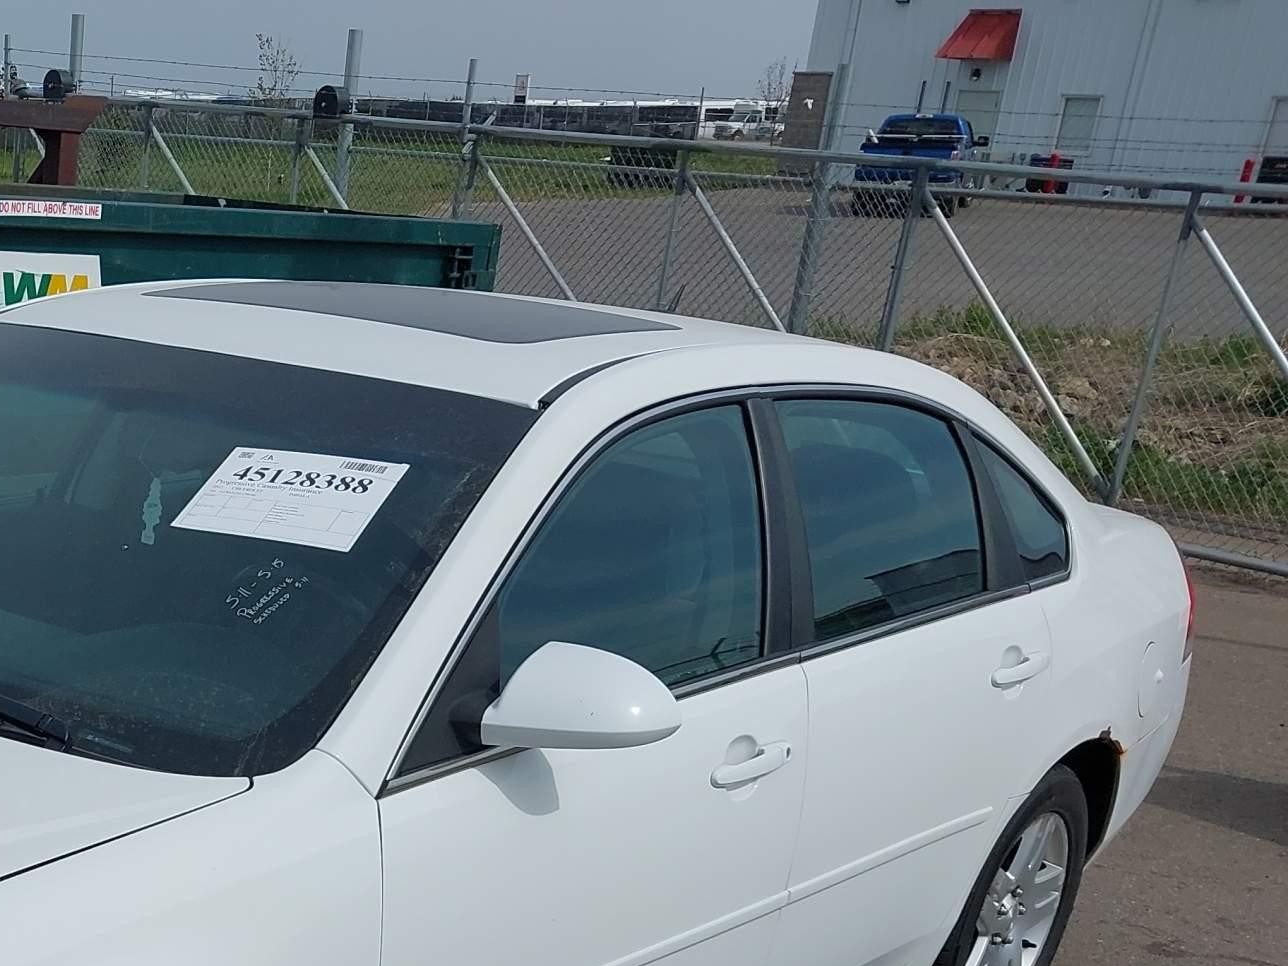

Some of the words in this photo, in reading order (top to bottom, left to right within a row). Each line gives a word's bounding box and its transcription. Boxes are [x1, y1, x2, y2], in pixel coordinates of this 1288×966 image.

[0, 202, 9, 213] DO
[11, 202, 25, 213] NOT
[27, 203, 41, 213] FILL
[43, 203, 67, 214] ABOVE
[68, 204, 83, 215] THIS
[84, 205, 100, 216] LINE
[232, 465, 373, 494] 45128388
